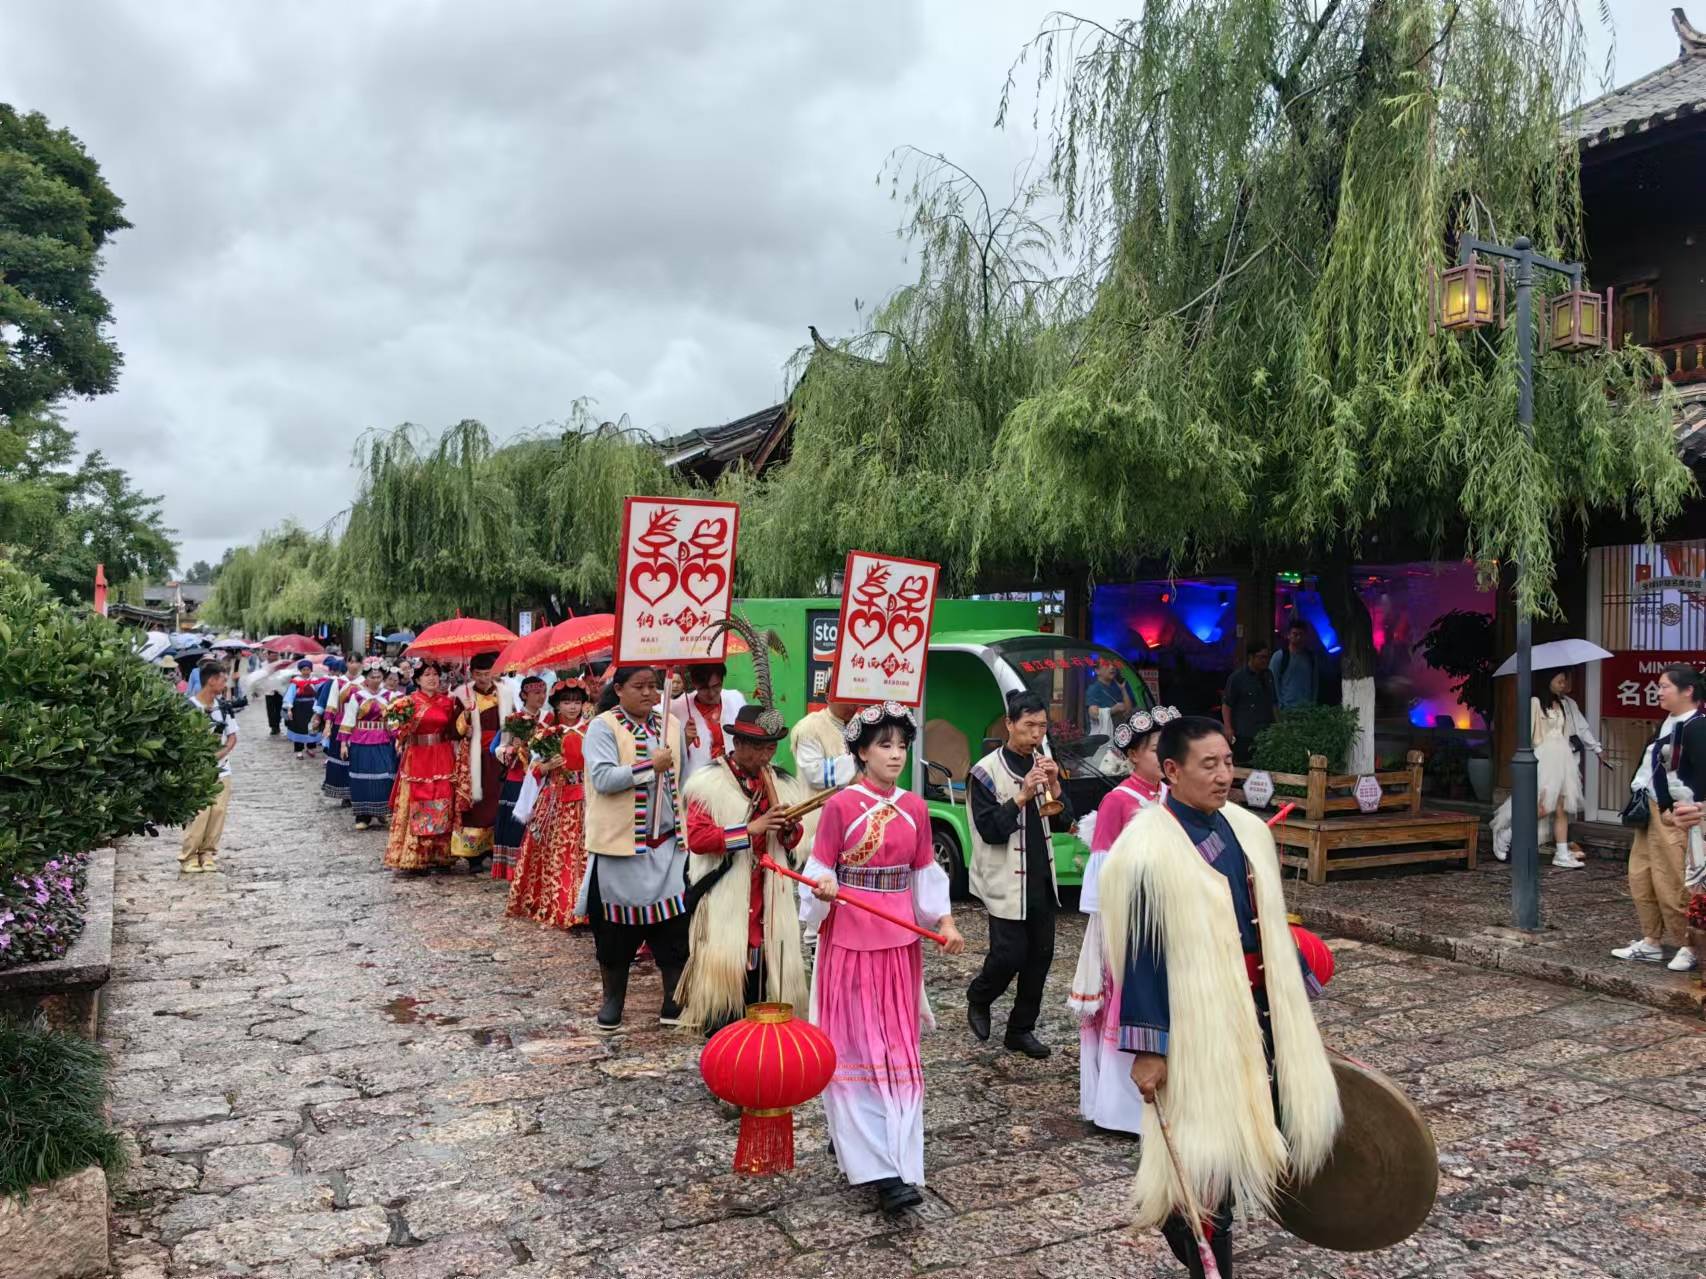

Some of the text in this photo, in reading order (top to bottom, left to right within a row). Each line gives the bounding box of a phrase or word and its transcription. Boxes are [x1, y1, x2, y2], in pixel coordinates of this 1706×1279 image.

[636, 609, 712, 630] 纳西婚礼
[850, 653, 915, 675] 纳西婚礼
